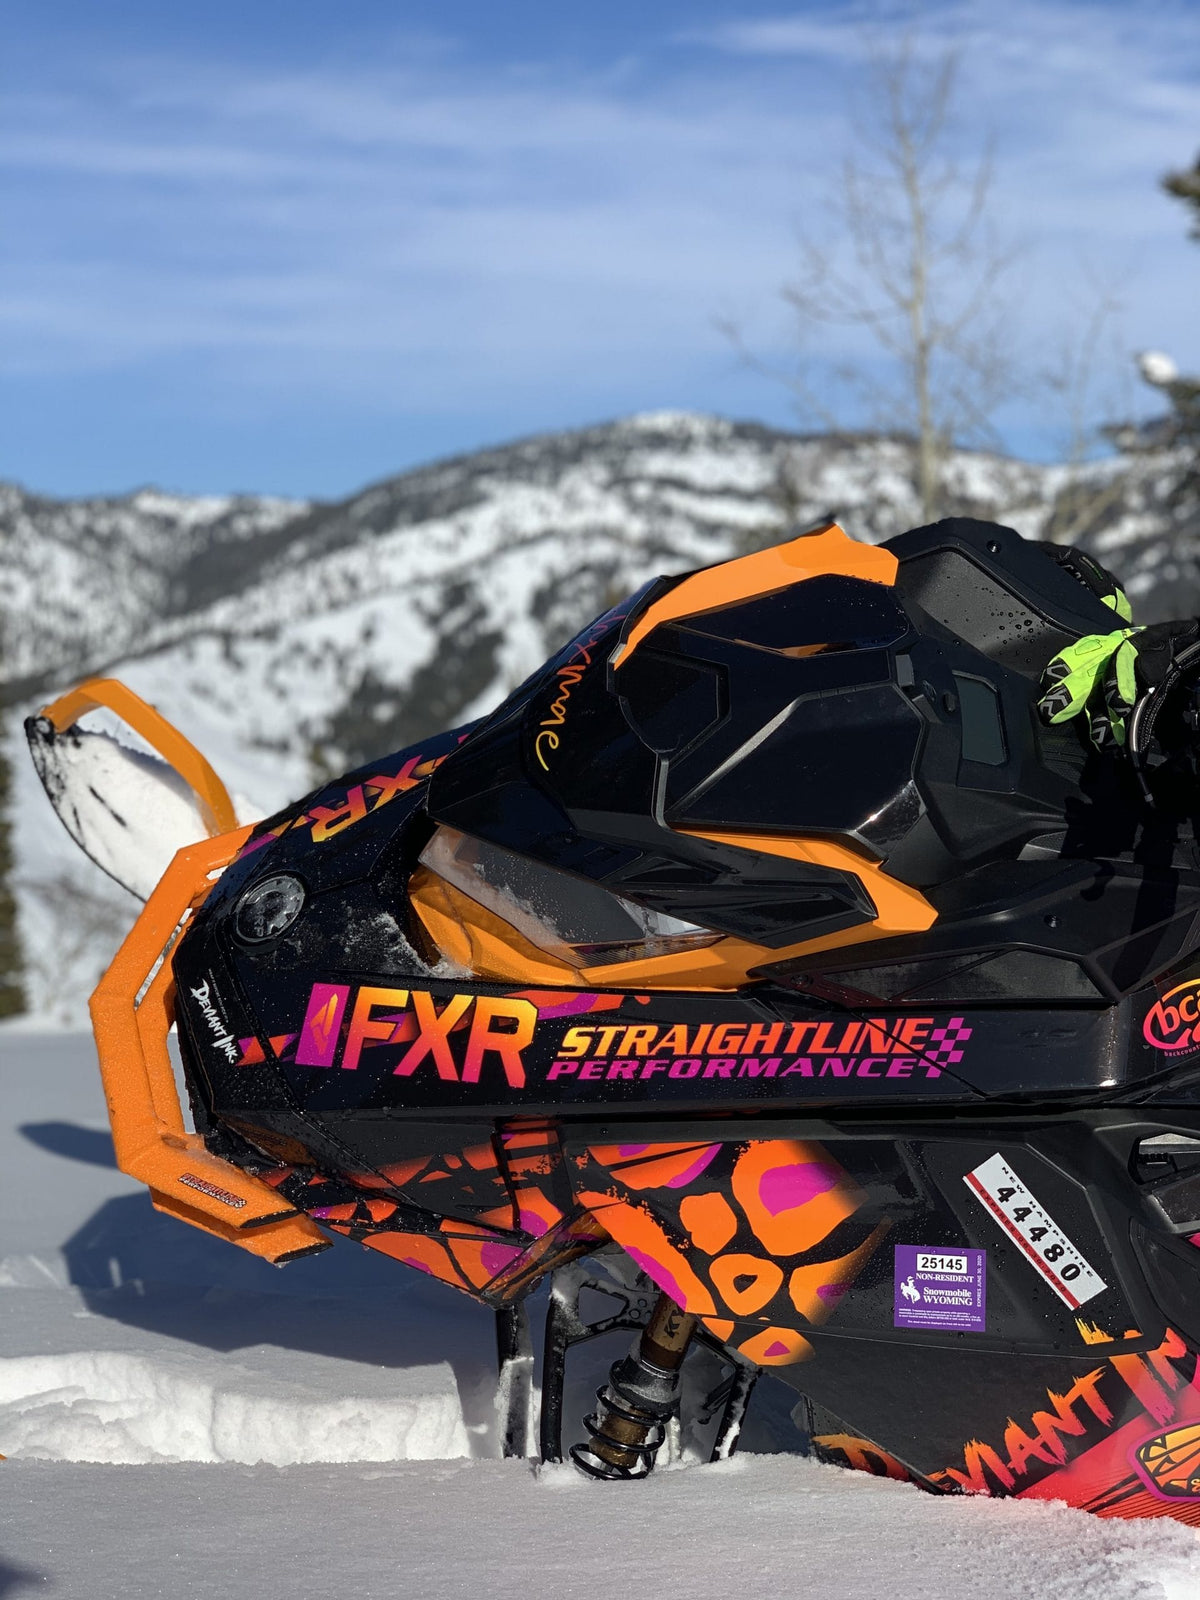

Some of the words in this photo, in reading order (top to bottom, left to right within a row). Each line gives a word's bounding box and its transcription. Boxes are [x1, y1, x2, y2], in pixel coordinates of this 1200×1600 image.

[309, 754, 448, 843] XR
[189, 978, 228, 1037] DEVIANT
[341, 986, 538, 1089] FXR
[557, 1017, 933, 1058] STRAIGHTLINE
[546, 1058, 915, 1081] PERFORMANCE
[996, 1187, 1081, 1281] 44480
[1002, 1166, 1025, 1194] NEW
[1029, 1200, 1094, 1278] HAMPSHIRE
[915, 1272, 975, 1284] NON-RESIDENT
[921, 1256, 963, 1271] 25145
[923, 1286, 972, 1298] Snowmobile
[923, 1295, 973, 1306] WYOMING
